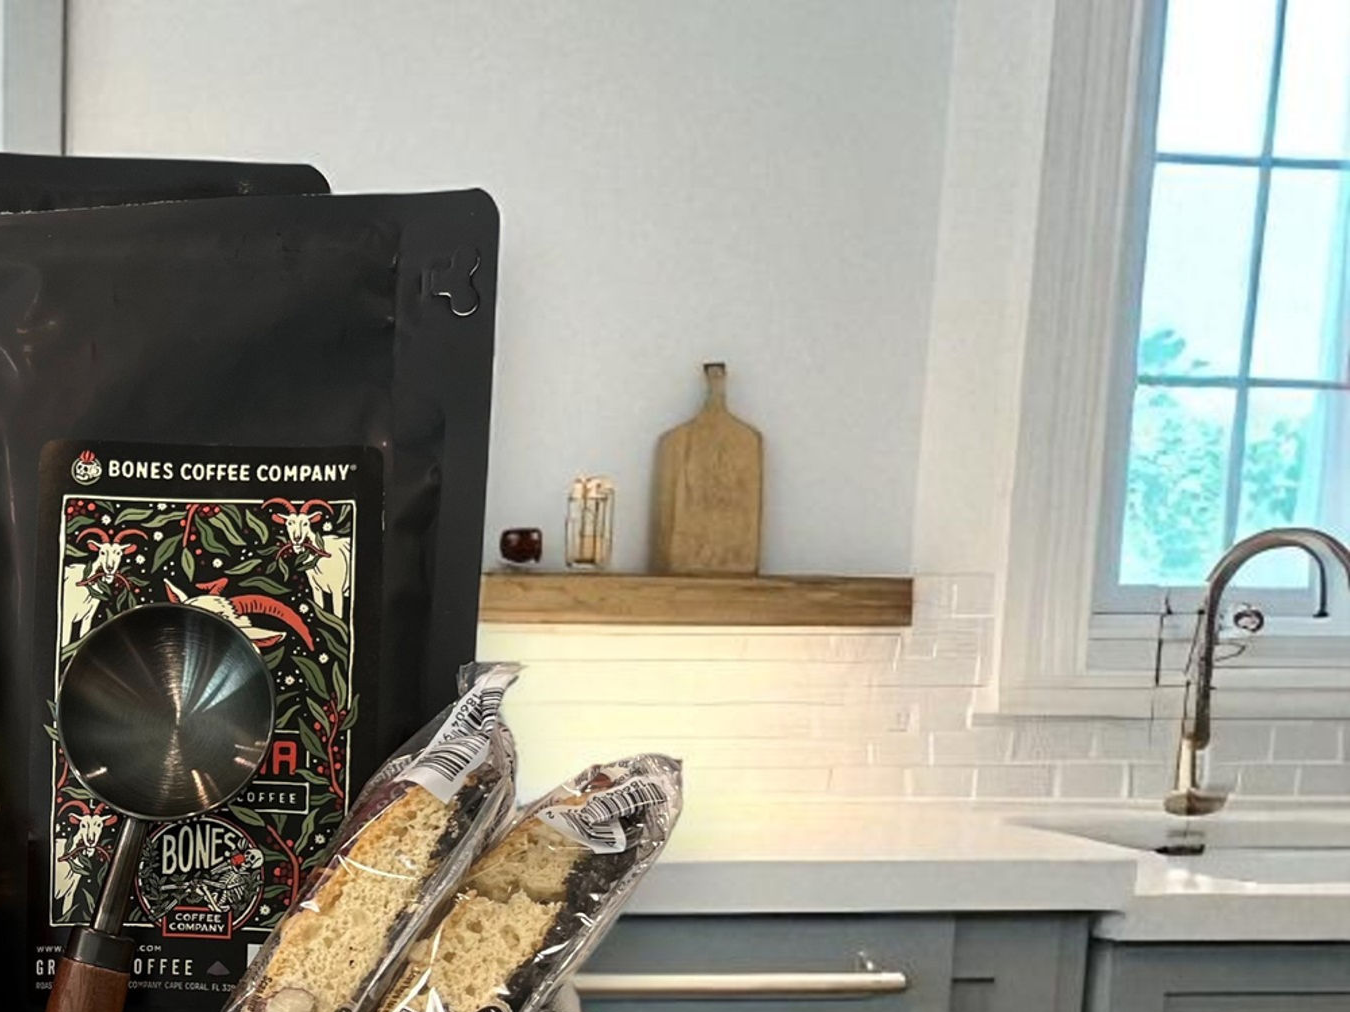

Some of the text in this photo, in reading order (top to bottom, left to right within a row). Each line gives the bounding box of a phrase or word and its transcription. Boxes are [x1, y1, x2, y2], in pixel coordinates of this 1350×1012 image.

[107, 460, 350, 483] BONES COFFEE COMPANY
[161, 824, 237, 875] BONES
[175, 912, 222, 923] COFFEE
[168, 922, 226, 933] COMPANY
[133, 958, 193, 976] OFFEE
